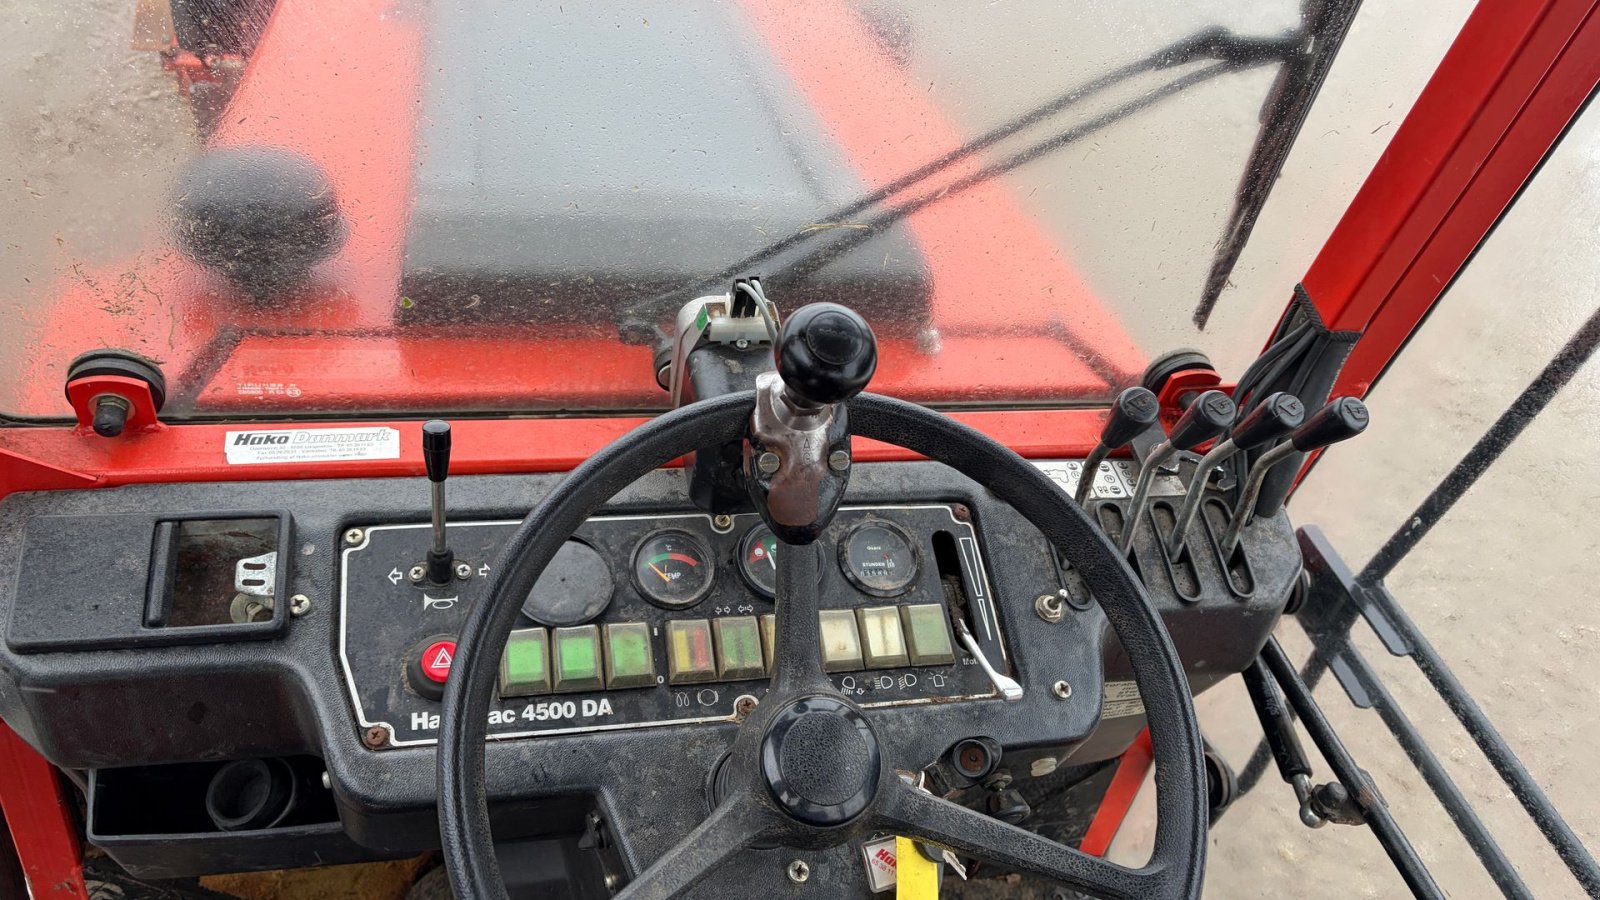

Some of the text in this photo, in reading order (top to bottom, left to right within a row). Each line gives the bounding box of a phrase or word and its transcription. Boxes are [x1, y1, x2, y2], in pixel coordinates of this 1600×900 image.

[233, 430, 390, 445] Hako Danmark
[521, 703, 577, 722] 4500
[581, 698, 614, 718] DA
